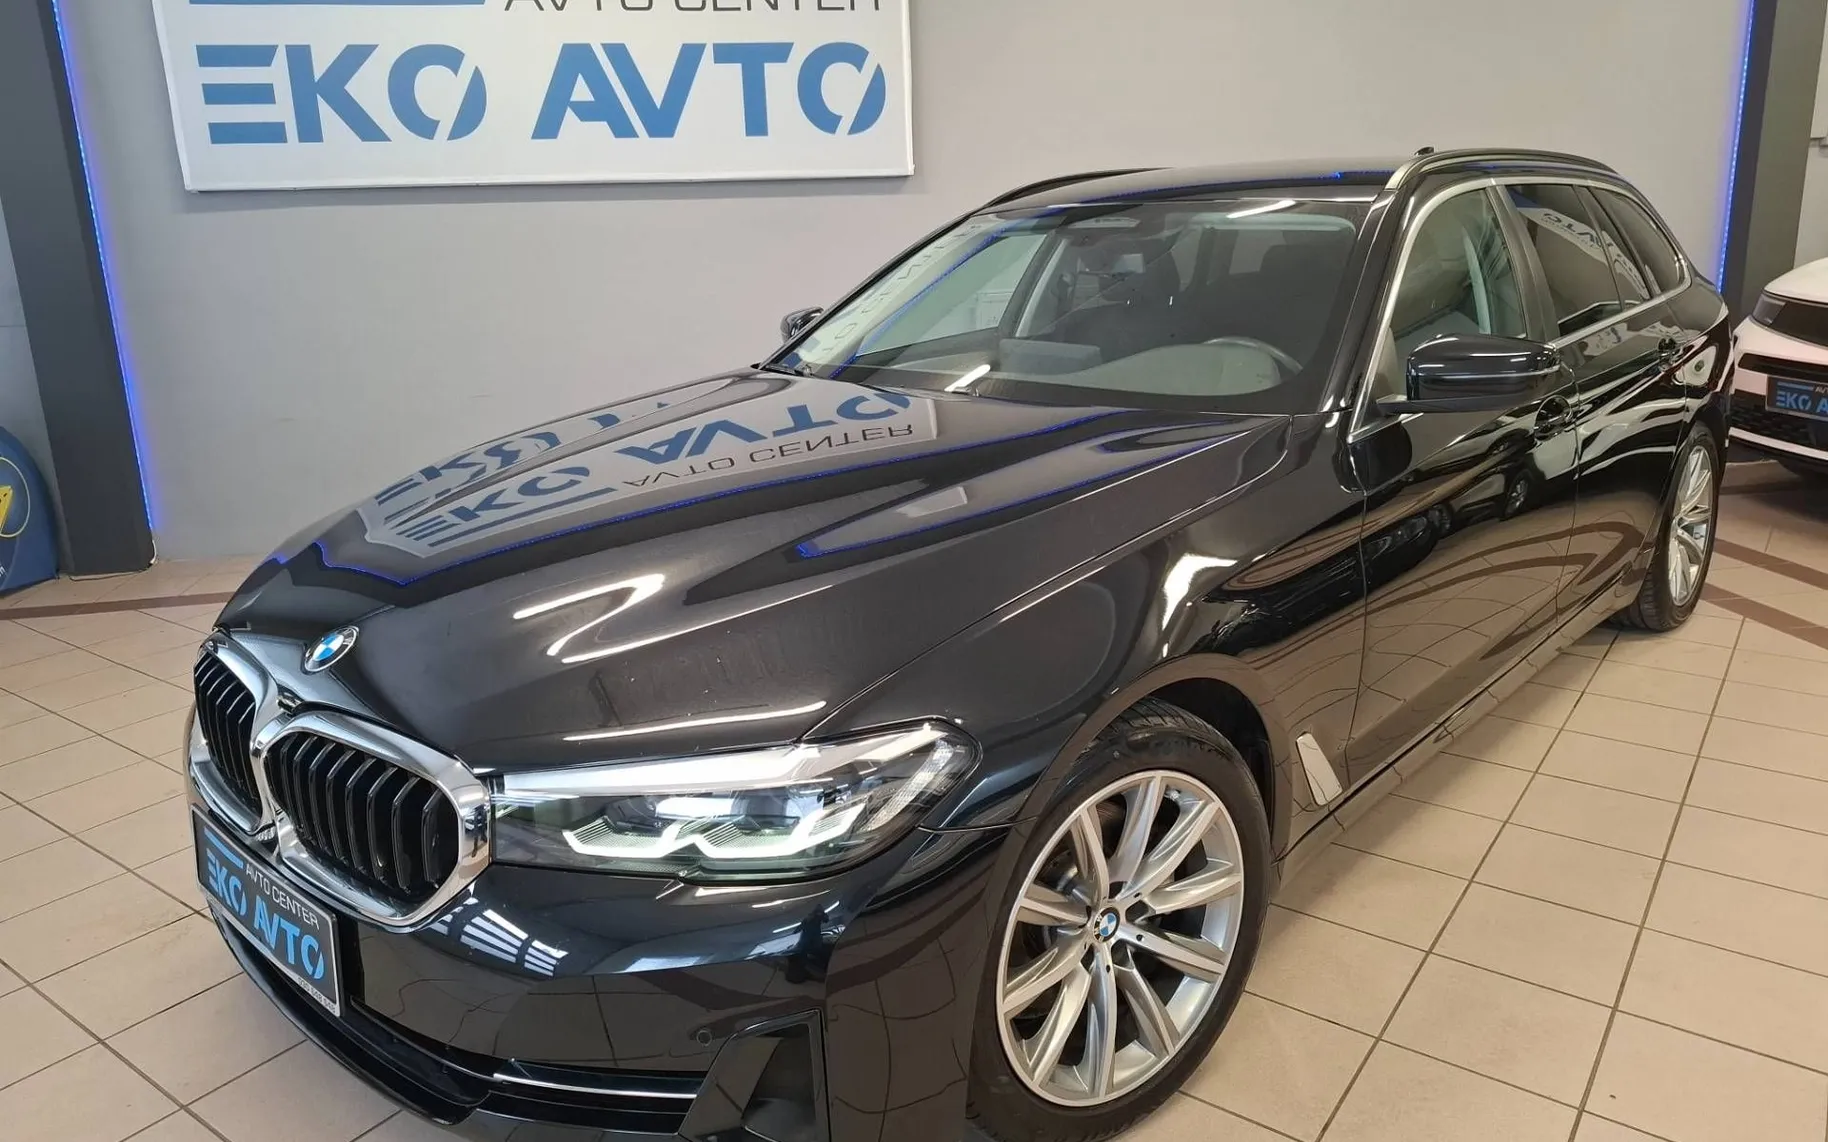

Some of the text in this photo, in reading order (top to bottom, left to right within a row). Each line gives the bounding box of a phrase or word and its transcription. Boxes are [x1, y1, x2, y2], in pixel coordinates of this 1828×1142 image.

[196, 42, 886, 145] EKO AVTO
[1776, 390, 1812, 411] EKO
[206, 847, 325, 980] EKO AVTO
[245, 864, 320, 930] AVTO CENTER
